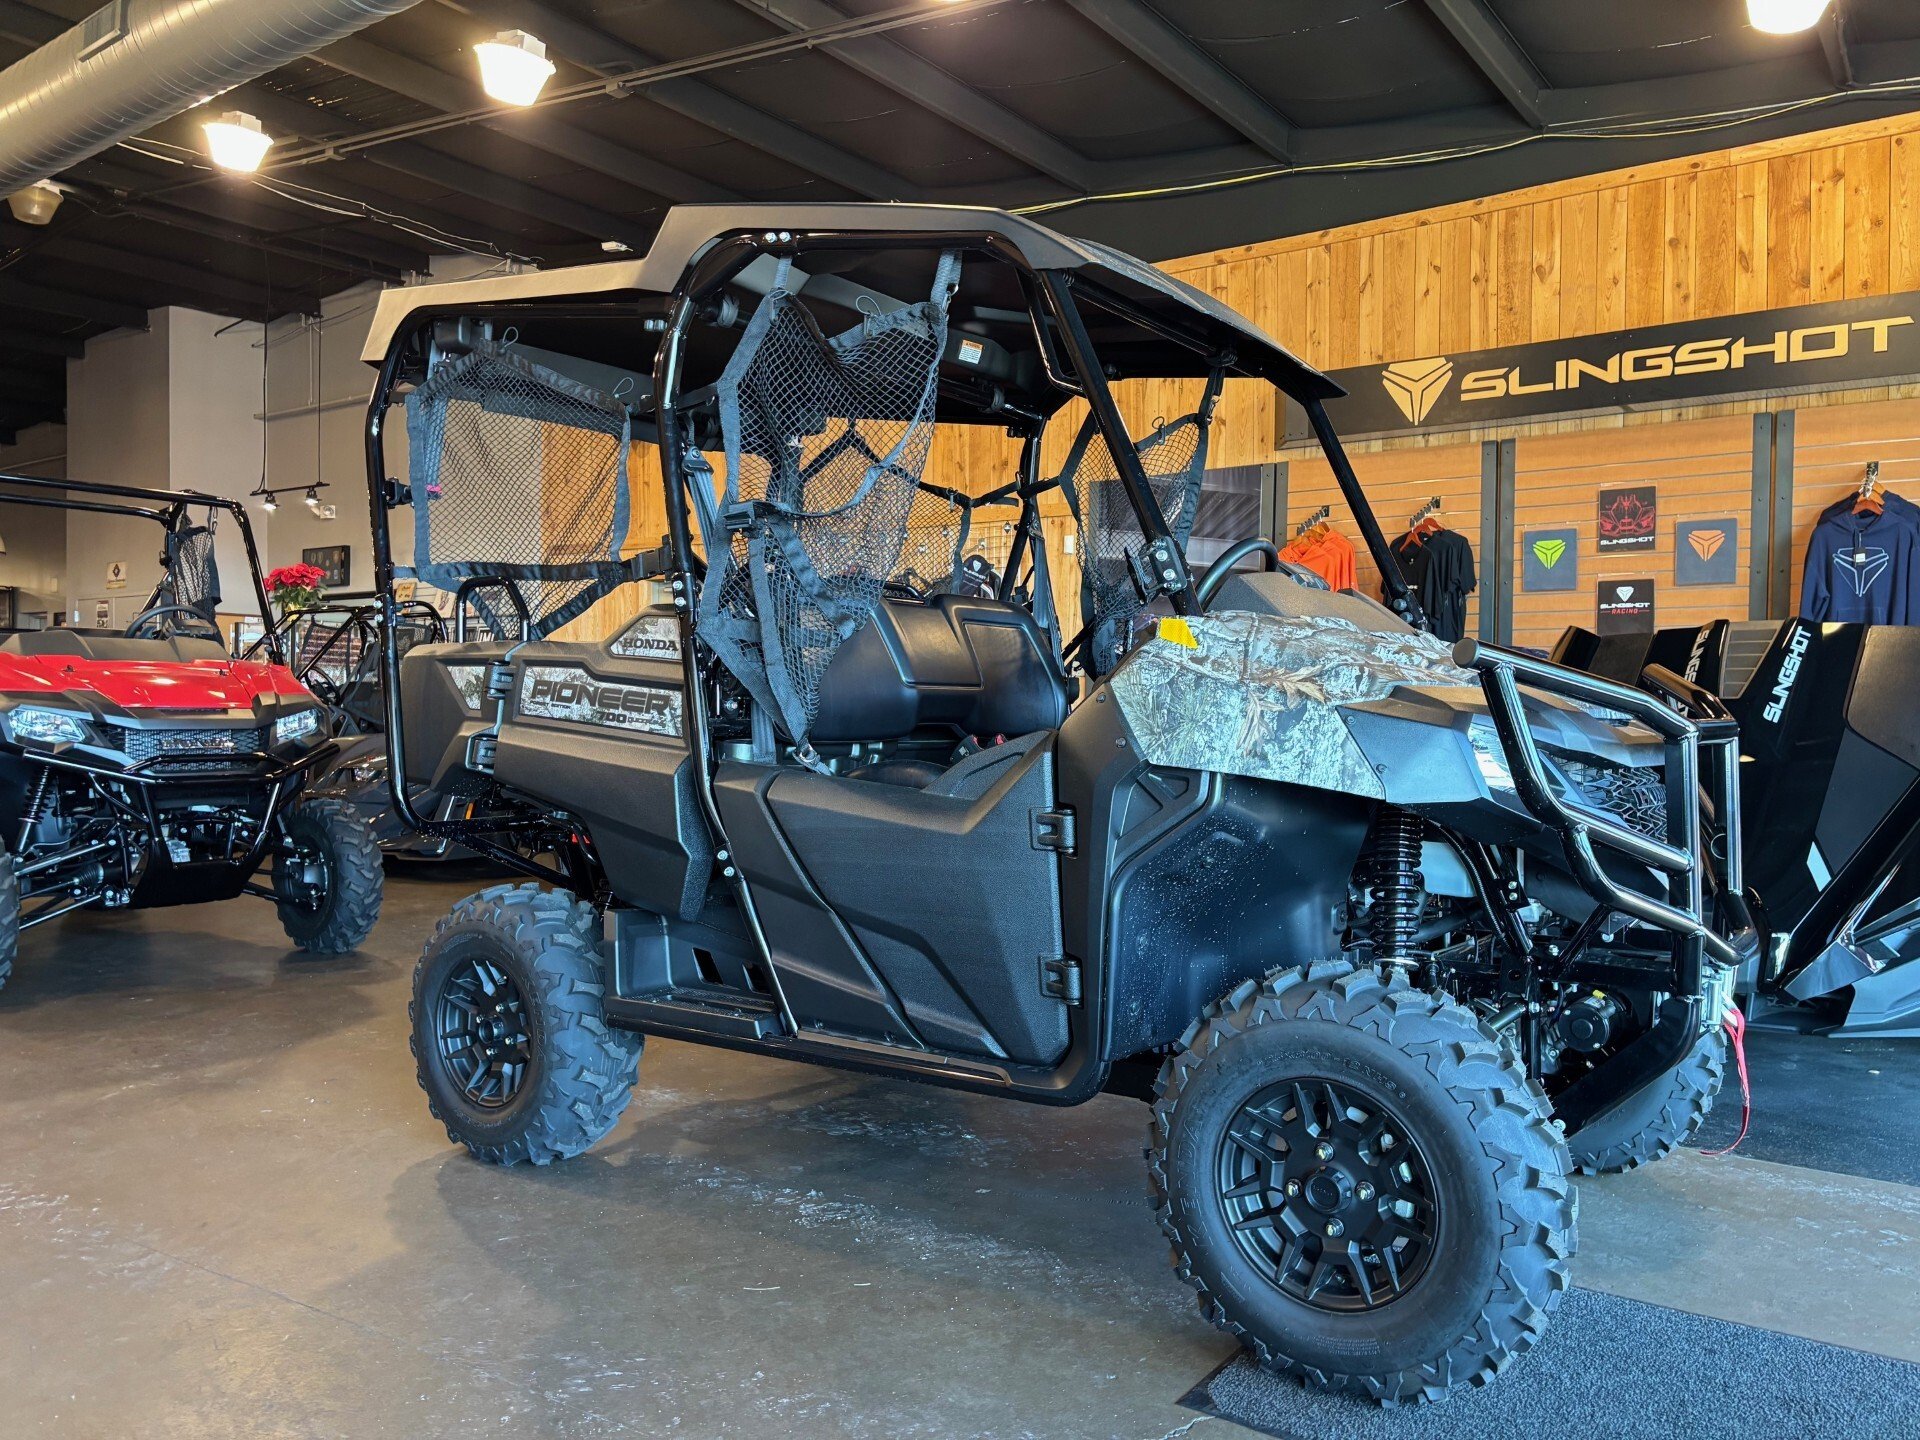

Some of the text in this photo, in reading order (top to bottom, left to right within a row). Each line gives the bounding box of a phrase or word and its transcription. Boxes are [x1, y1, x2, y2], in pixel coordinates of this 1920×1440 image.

[1461, 315, 1915, 401] SLINGSHOT
[1601, 536, 1654, 545] SLINGSHOT
[622, 637, 679, 651] HONDA
[1762, 625, 1812, 724] SLINGSHOT
[530, 679, 671, 717] PIONEER
